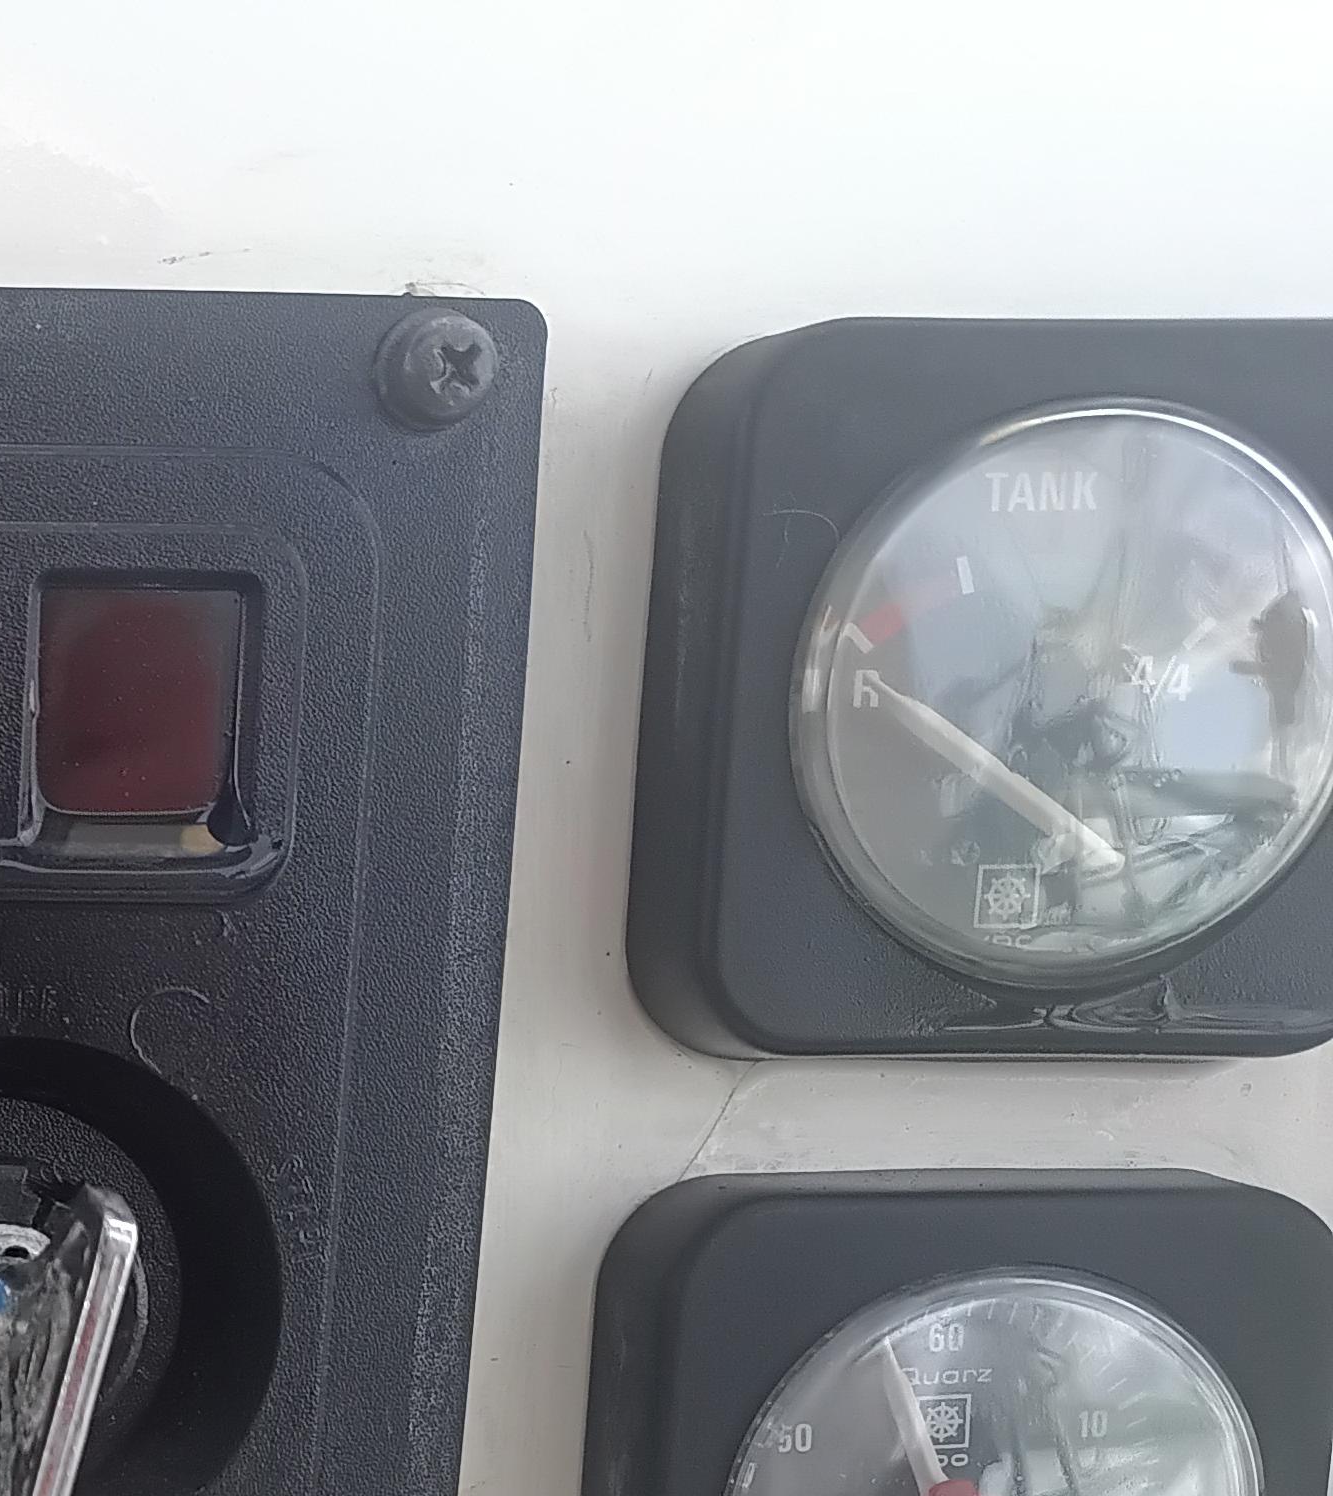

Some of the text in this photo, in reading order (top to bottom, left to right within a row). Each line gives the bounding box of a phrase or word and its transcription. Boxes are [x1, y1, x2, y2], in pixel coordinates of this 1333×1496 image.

[985, 471, 1100, 513] TANK
[929, 1322, 965, 1352] 60
[1078, 1411, 1108, 1438] 10
